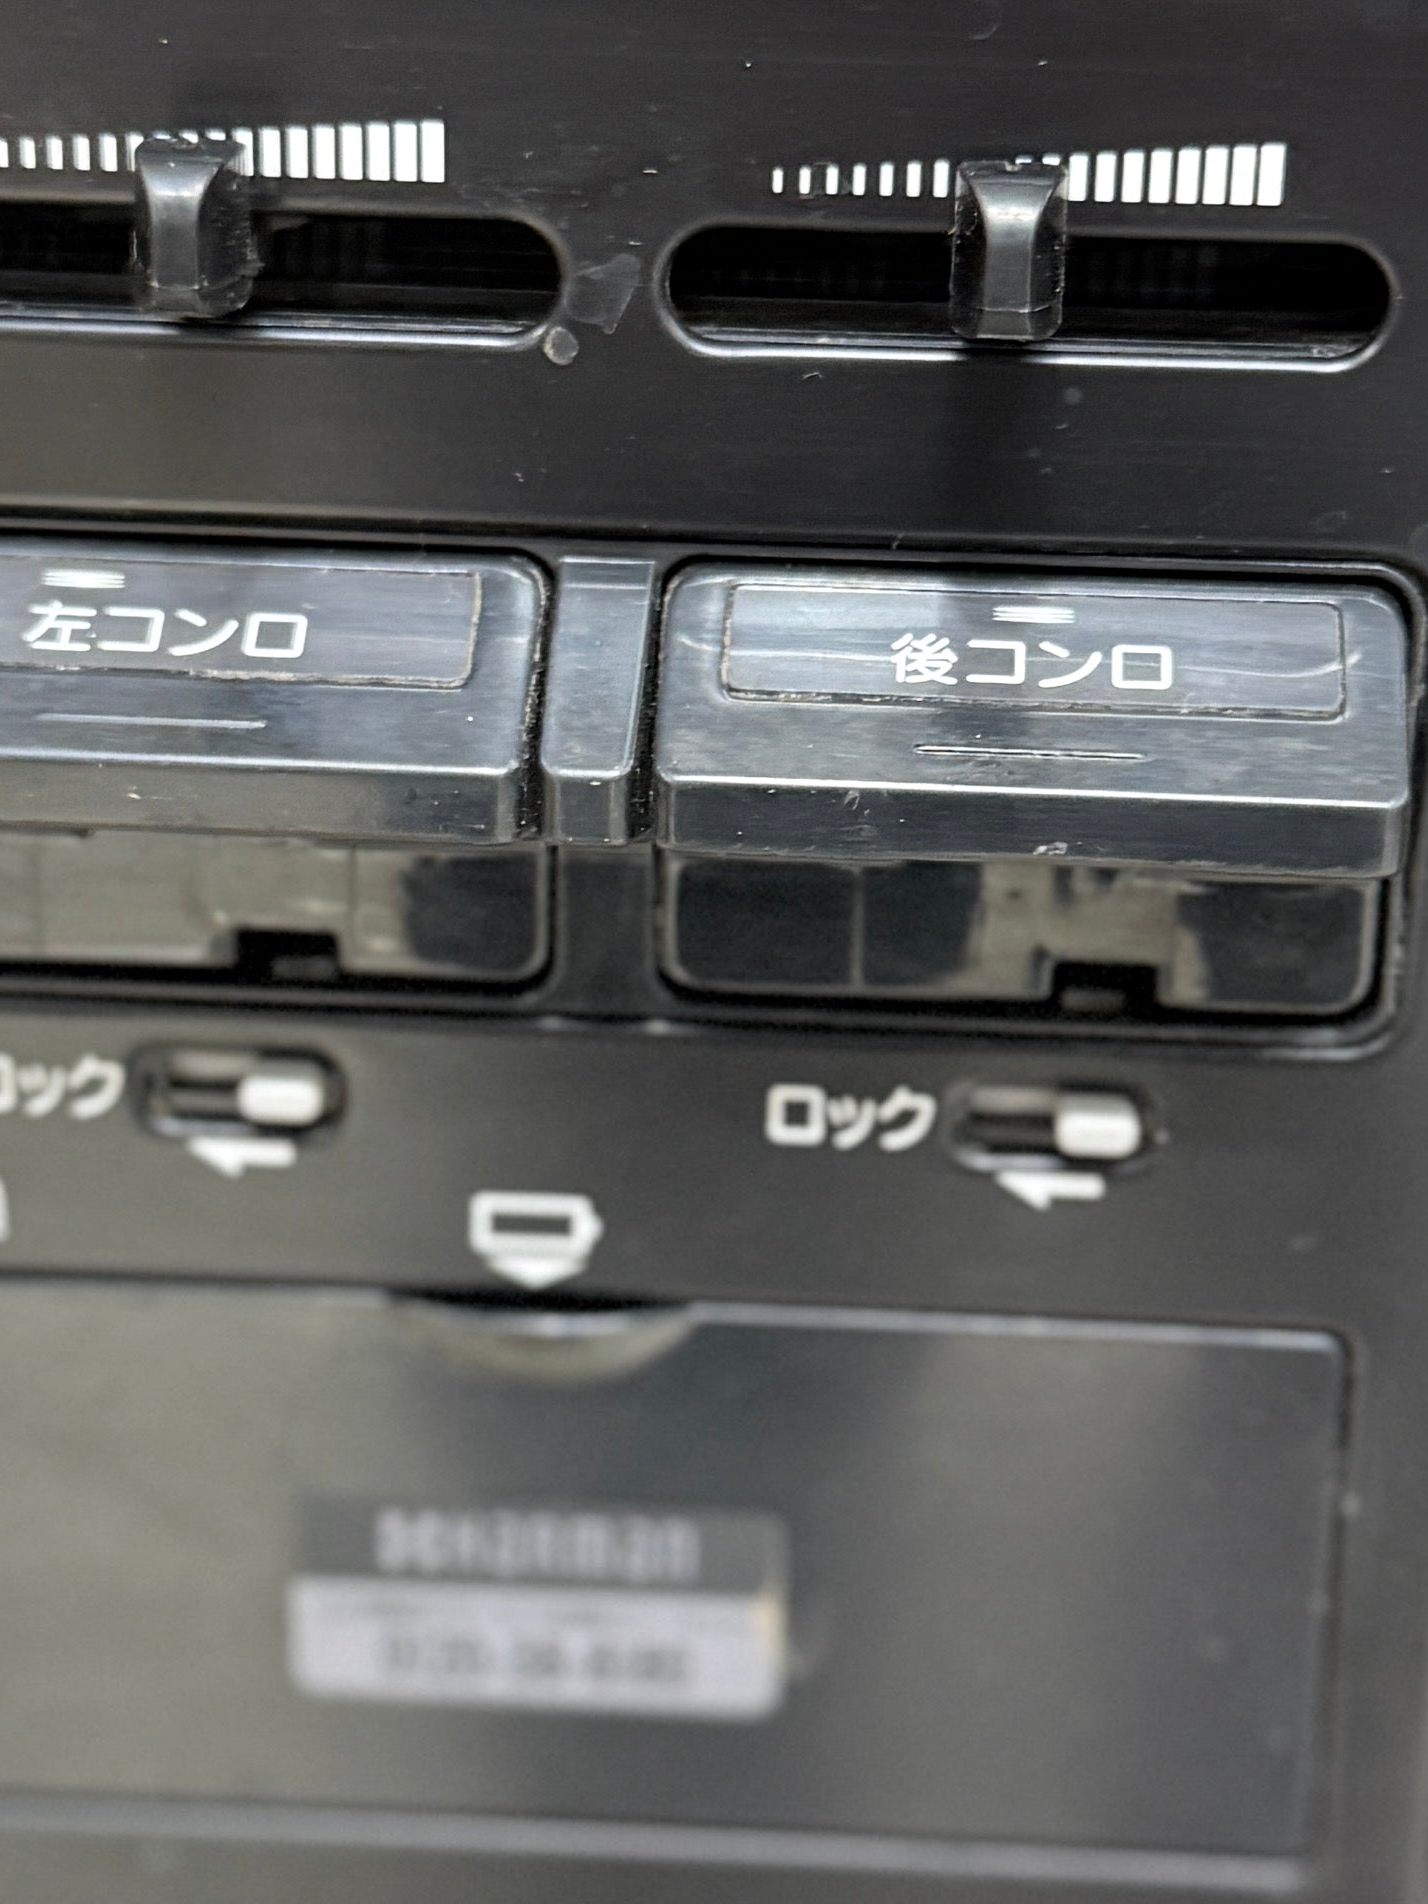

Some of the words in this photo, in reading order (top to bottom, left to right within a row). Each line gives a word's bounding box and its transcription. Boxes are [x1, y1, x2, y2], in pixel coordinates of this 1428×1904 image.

[22, 599, 308, 659] 左コンロ
[890, 632, 1173, 690] 後コンロ
[766, 1084, 936, 1150] ロック
